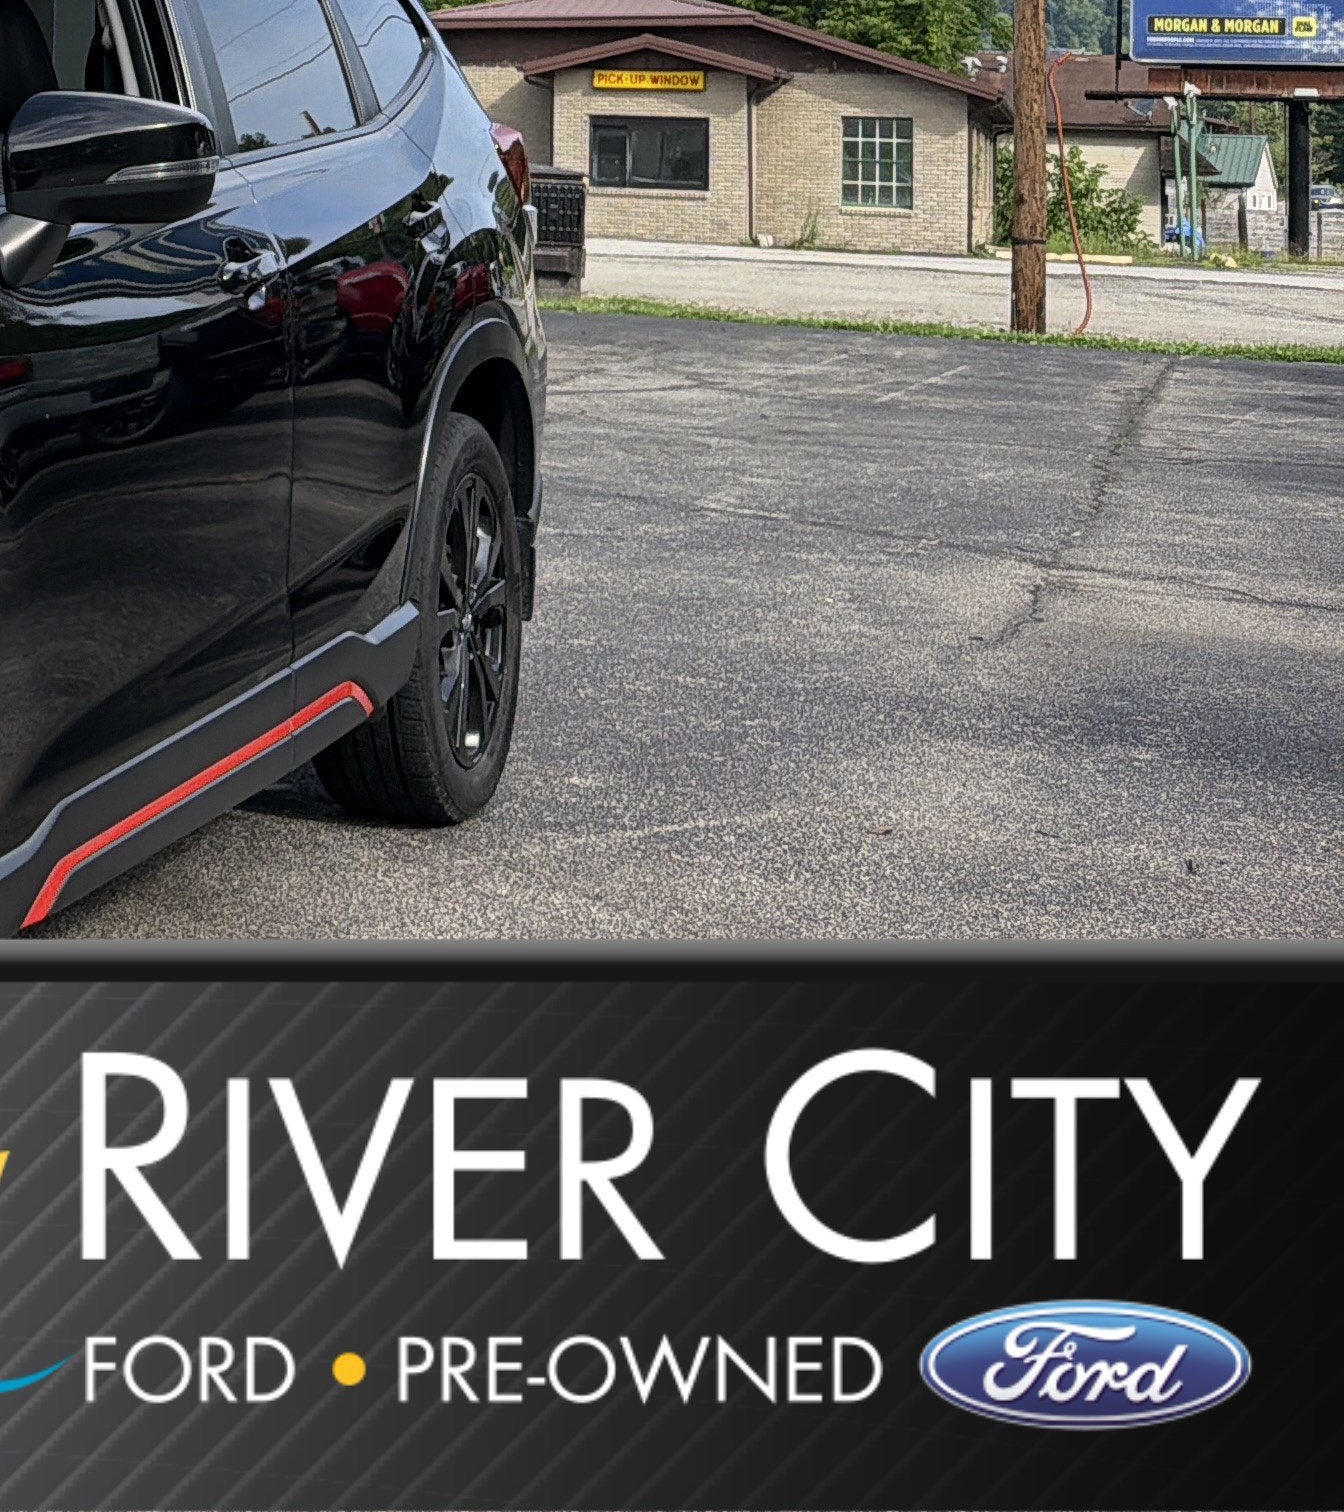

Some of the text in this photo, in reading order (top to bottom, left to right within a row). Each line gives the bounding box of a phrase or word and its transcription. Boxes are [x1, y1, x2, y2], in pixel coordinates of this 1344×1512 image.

[1153, 17, 1208, 32] MORGAN
[1211, 18, 1221, 32] &
[1224, 18, 1280, 34] MORGAN
[650, 73, 700, 86] WINDOW
